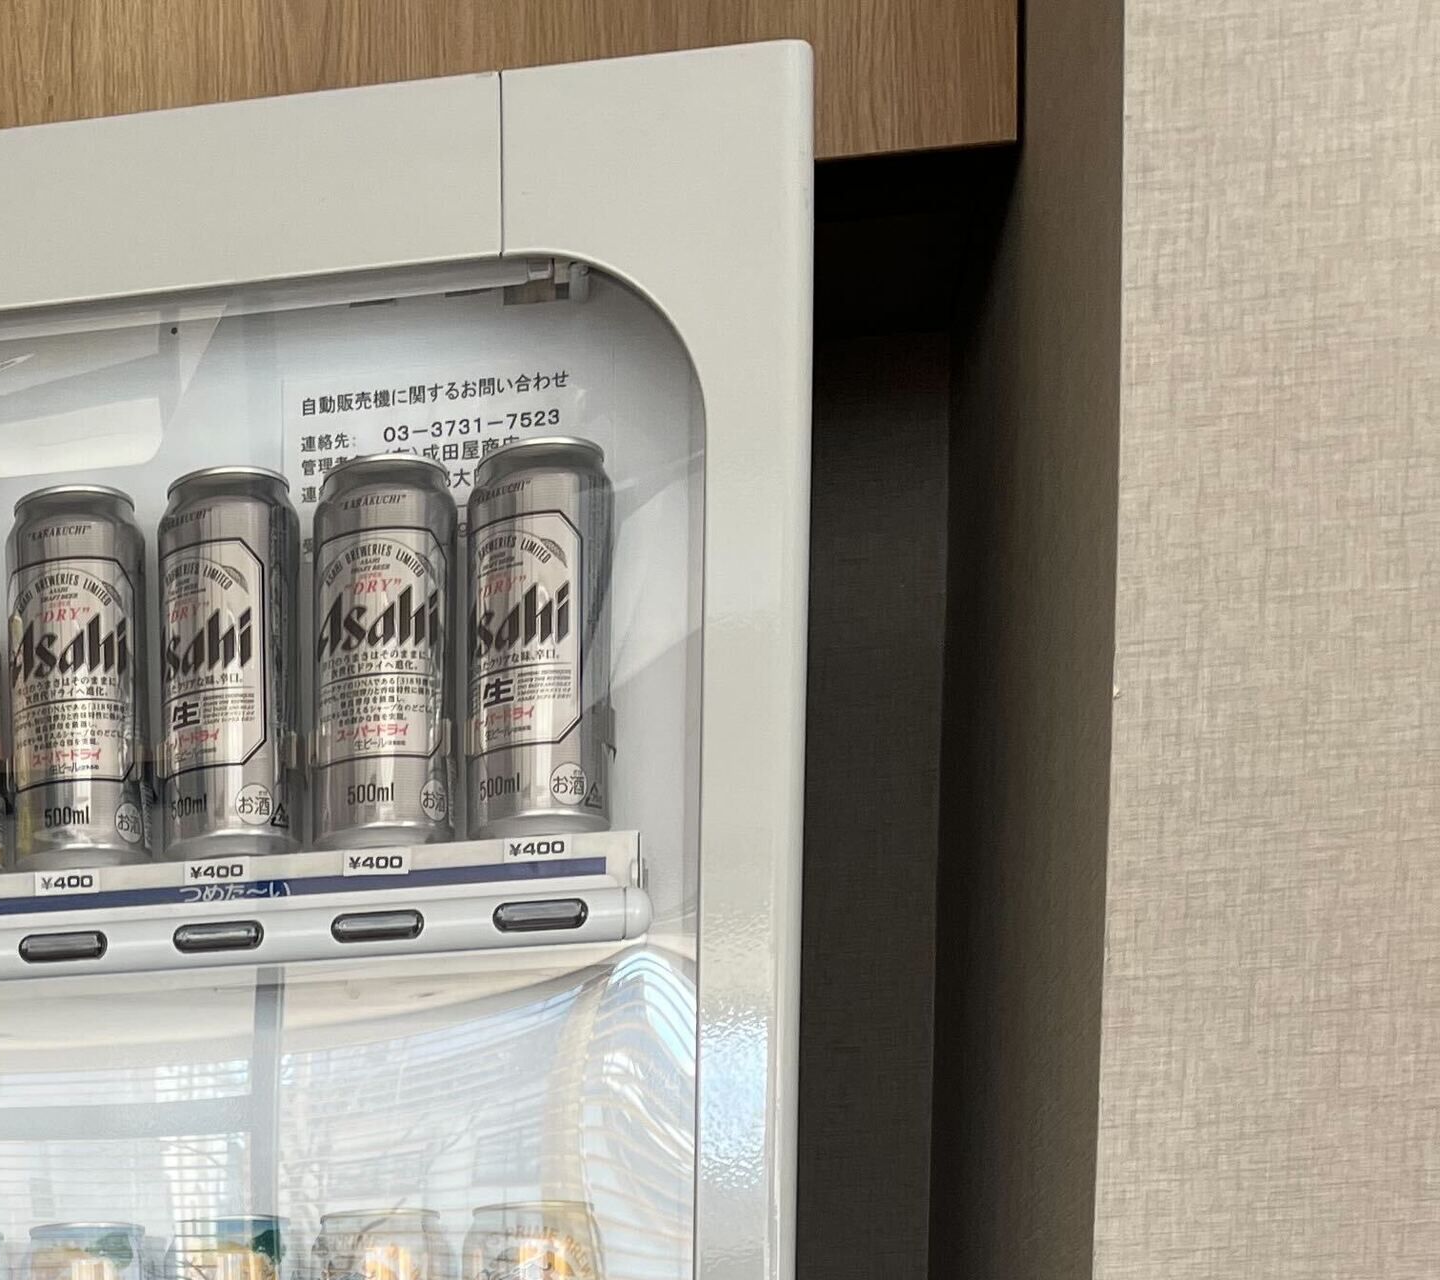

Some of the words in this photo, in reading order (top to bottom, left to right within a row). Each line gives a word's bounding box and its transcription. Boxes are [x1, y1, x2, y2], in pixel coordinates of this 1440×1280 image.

[302, 370, 569, 416] 自動販売機に関するお問い合わせ
[395, 550, 426, 578] LIMITED
[520, 539, 552, 564] LIMITED
[203, 565, 233, 590] LIMITED
[83, 578, 113, 607] LIMITED
[317, 584, 439, 662] Asahi
[11, 612, 127, 688] Asahi
[484, 678, 514, 708] 生
[173, 701, 200, 731] 生
[337, 724, 409, 743] スーパードライ
[33, 750, 101, 768] スーパードライ
[347, 782, 394, 806] 500ml
[480, 773, 520, 801] 500ml
[553, 773, 584, 795] お酒
[171, 793, 207, 821] 500ml
[238, 792, 270, 816] お酒
[44, 806, 89, 829] 500ml
[509, 840, 565, 856] ¥400
[190, 864, 244, 879] ¥400
[349, 855, 403, 871] ¥400
[41, 875, 93, 890] ¥400
